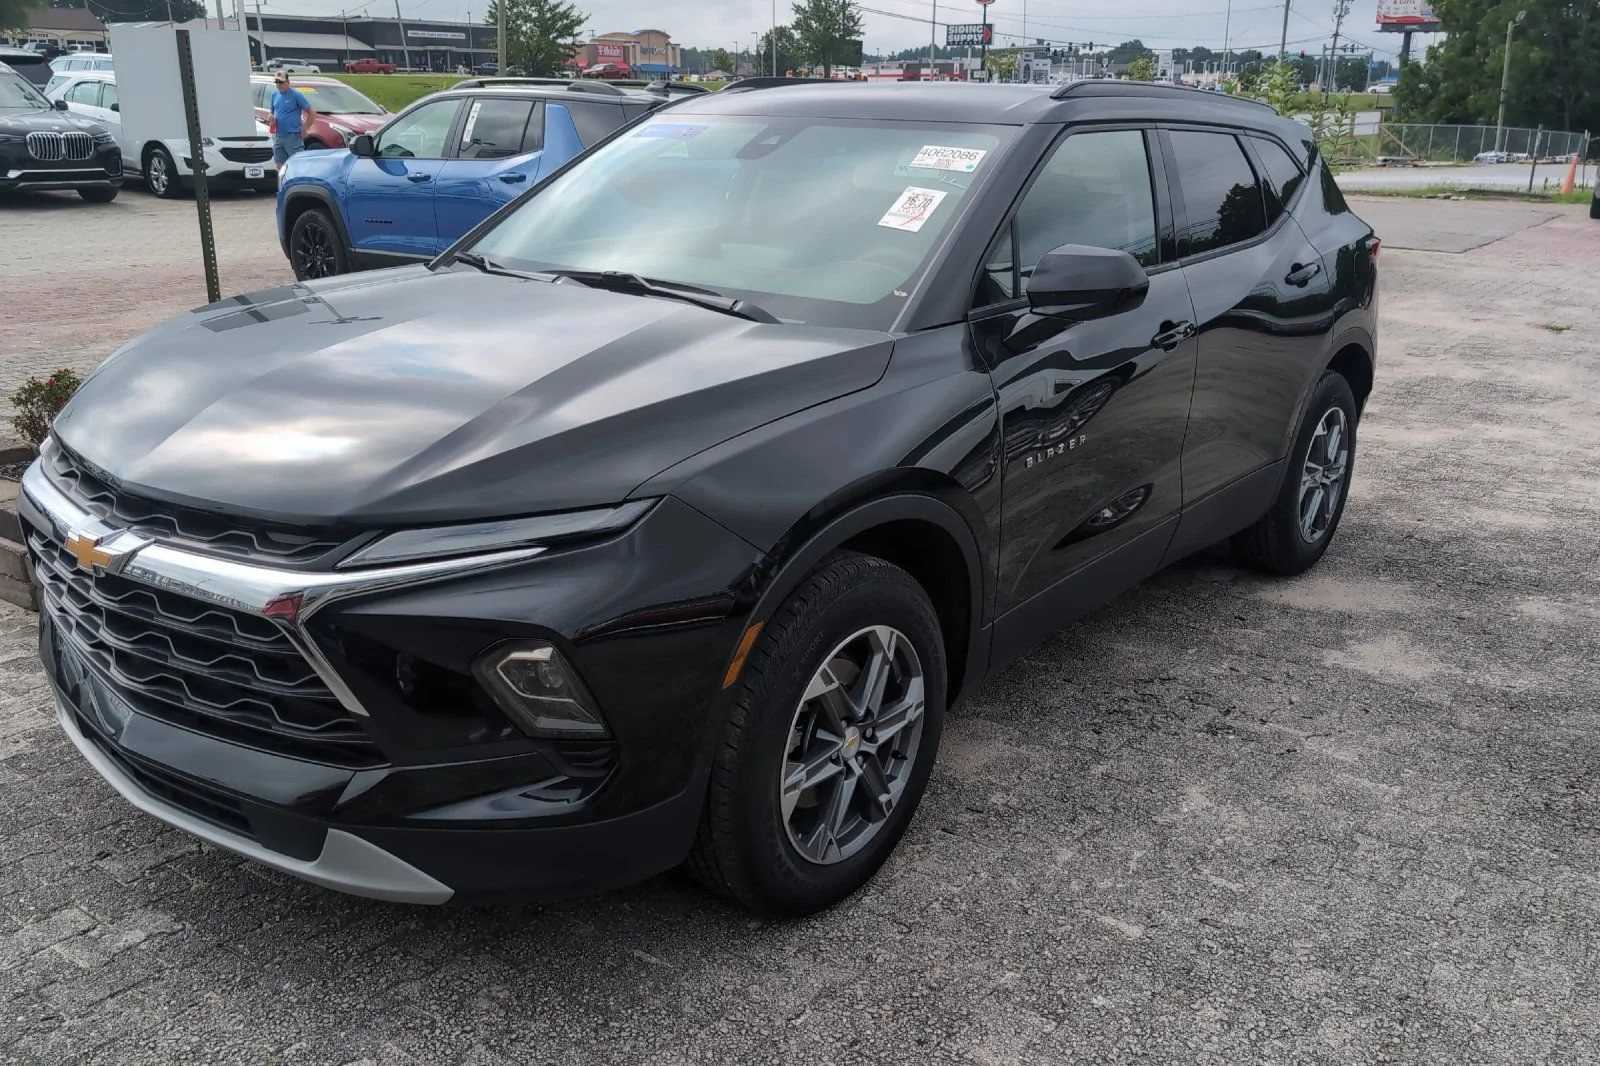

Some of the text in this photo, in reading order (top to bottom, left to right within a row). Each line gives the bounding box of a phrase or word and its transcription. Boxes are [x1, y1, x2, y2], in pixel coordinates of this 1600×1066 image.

[948, 25, 983, 34] SIDING
[948, 34, 983, 42] SUPPLY
[920, 148, 979, 161] 4062086
[1026, 435, 1085, 468] BLAZER
